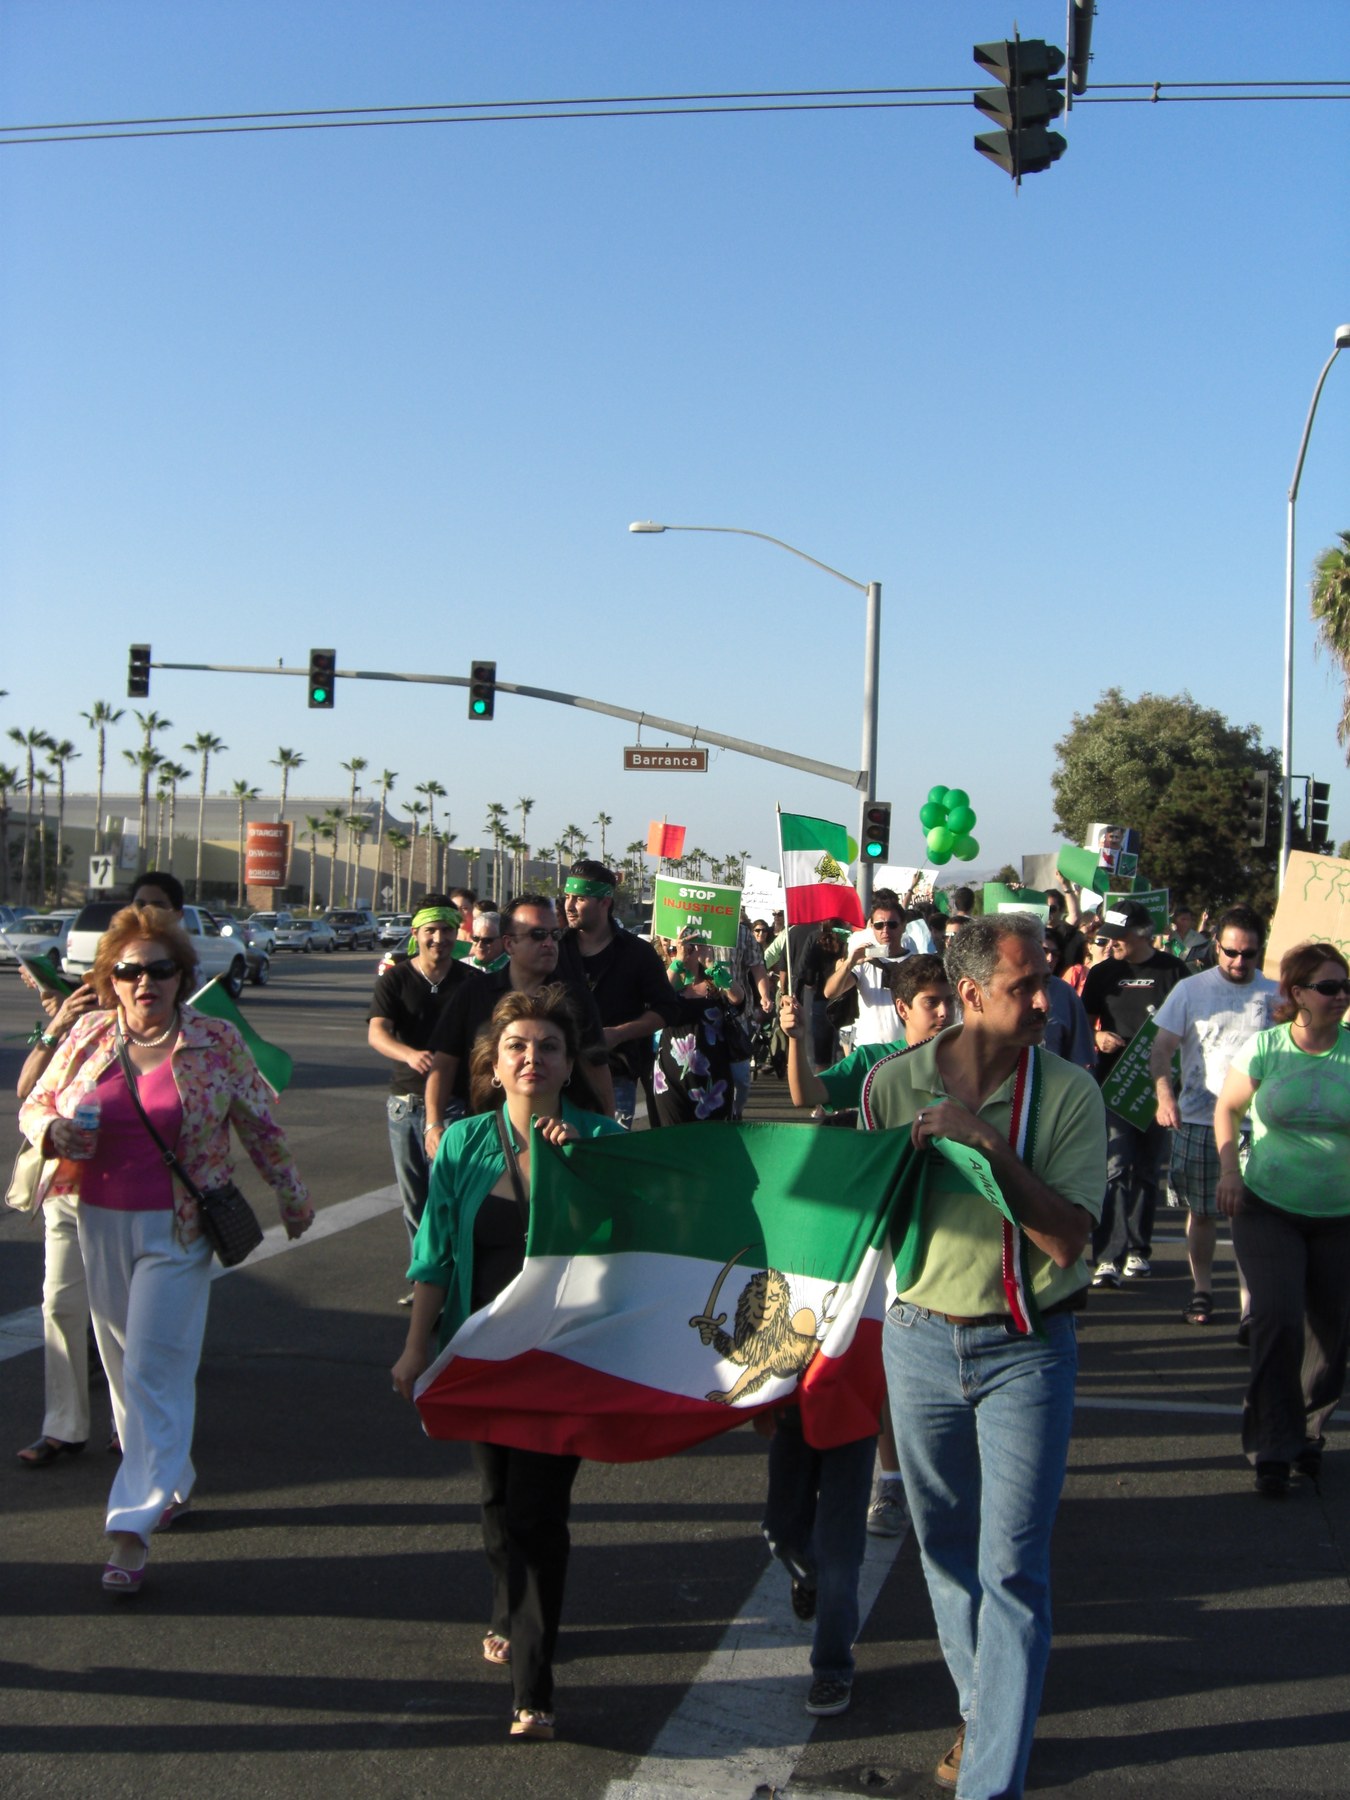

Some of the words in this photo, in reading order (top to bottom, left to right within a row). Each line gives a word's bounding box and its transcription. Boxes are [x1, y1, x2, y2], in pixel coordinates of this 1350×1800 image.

[632, 754, 698, 766] Barranca
[255, 829, 283, 837] TARGET
[678, 887, 716, 900] STOP
[663, 897, 734, 915] INJUSTICE
[686, 914, 703, 925] IN
[676, 926, 713, 940] IRAN
[1111, 1035, 1149, 1083] Voices
[1110, 1063, 1143, 1106] Count
